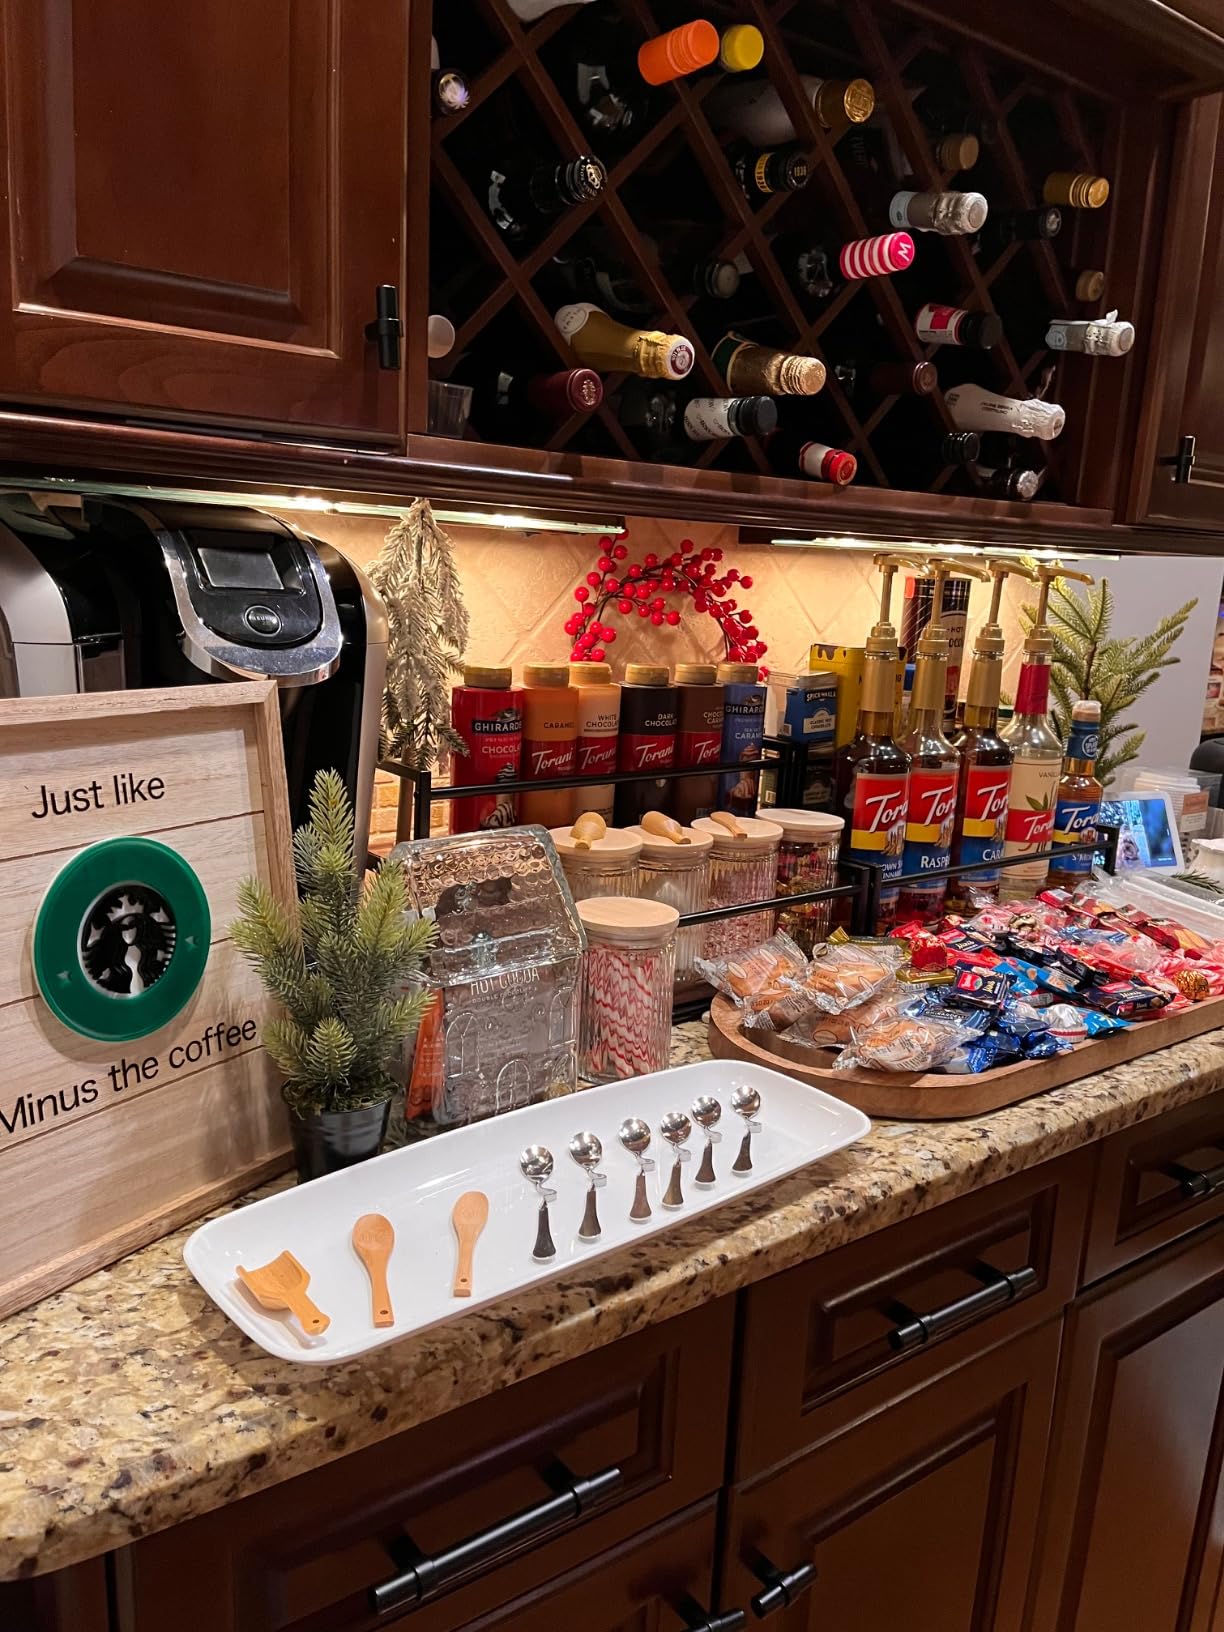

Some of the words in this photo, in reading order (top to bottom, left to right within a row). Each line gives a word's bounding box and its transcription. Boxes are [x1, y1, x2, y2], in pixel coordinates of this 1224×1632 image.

[597, 713, 617, 721] WHITE
[531, 747, 573, 775] Torani
[31, 778, 105, 819] Just
[112, 772, 166, 807] like
[0, 1079, 100, 1136] Minus
[107, 1055, 160, 1093] the
[167, 1018, 258, 1069] coffee
